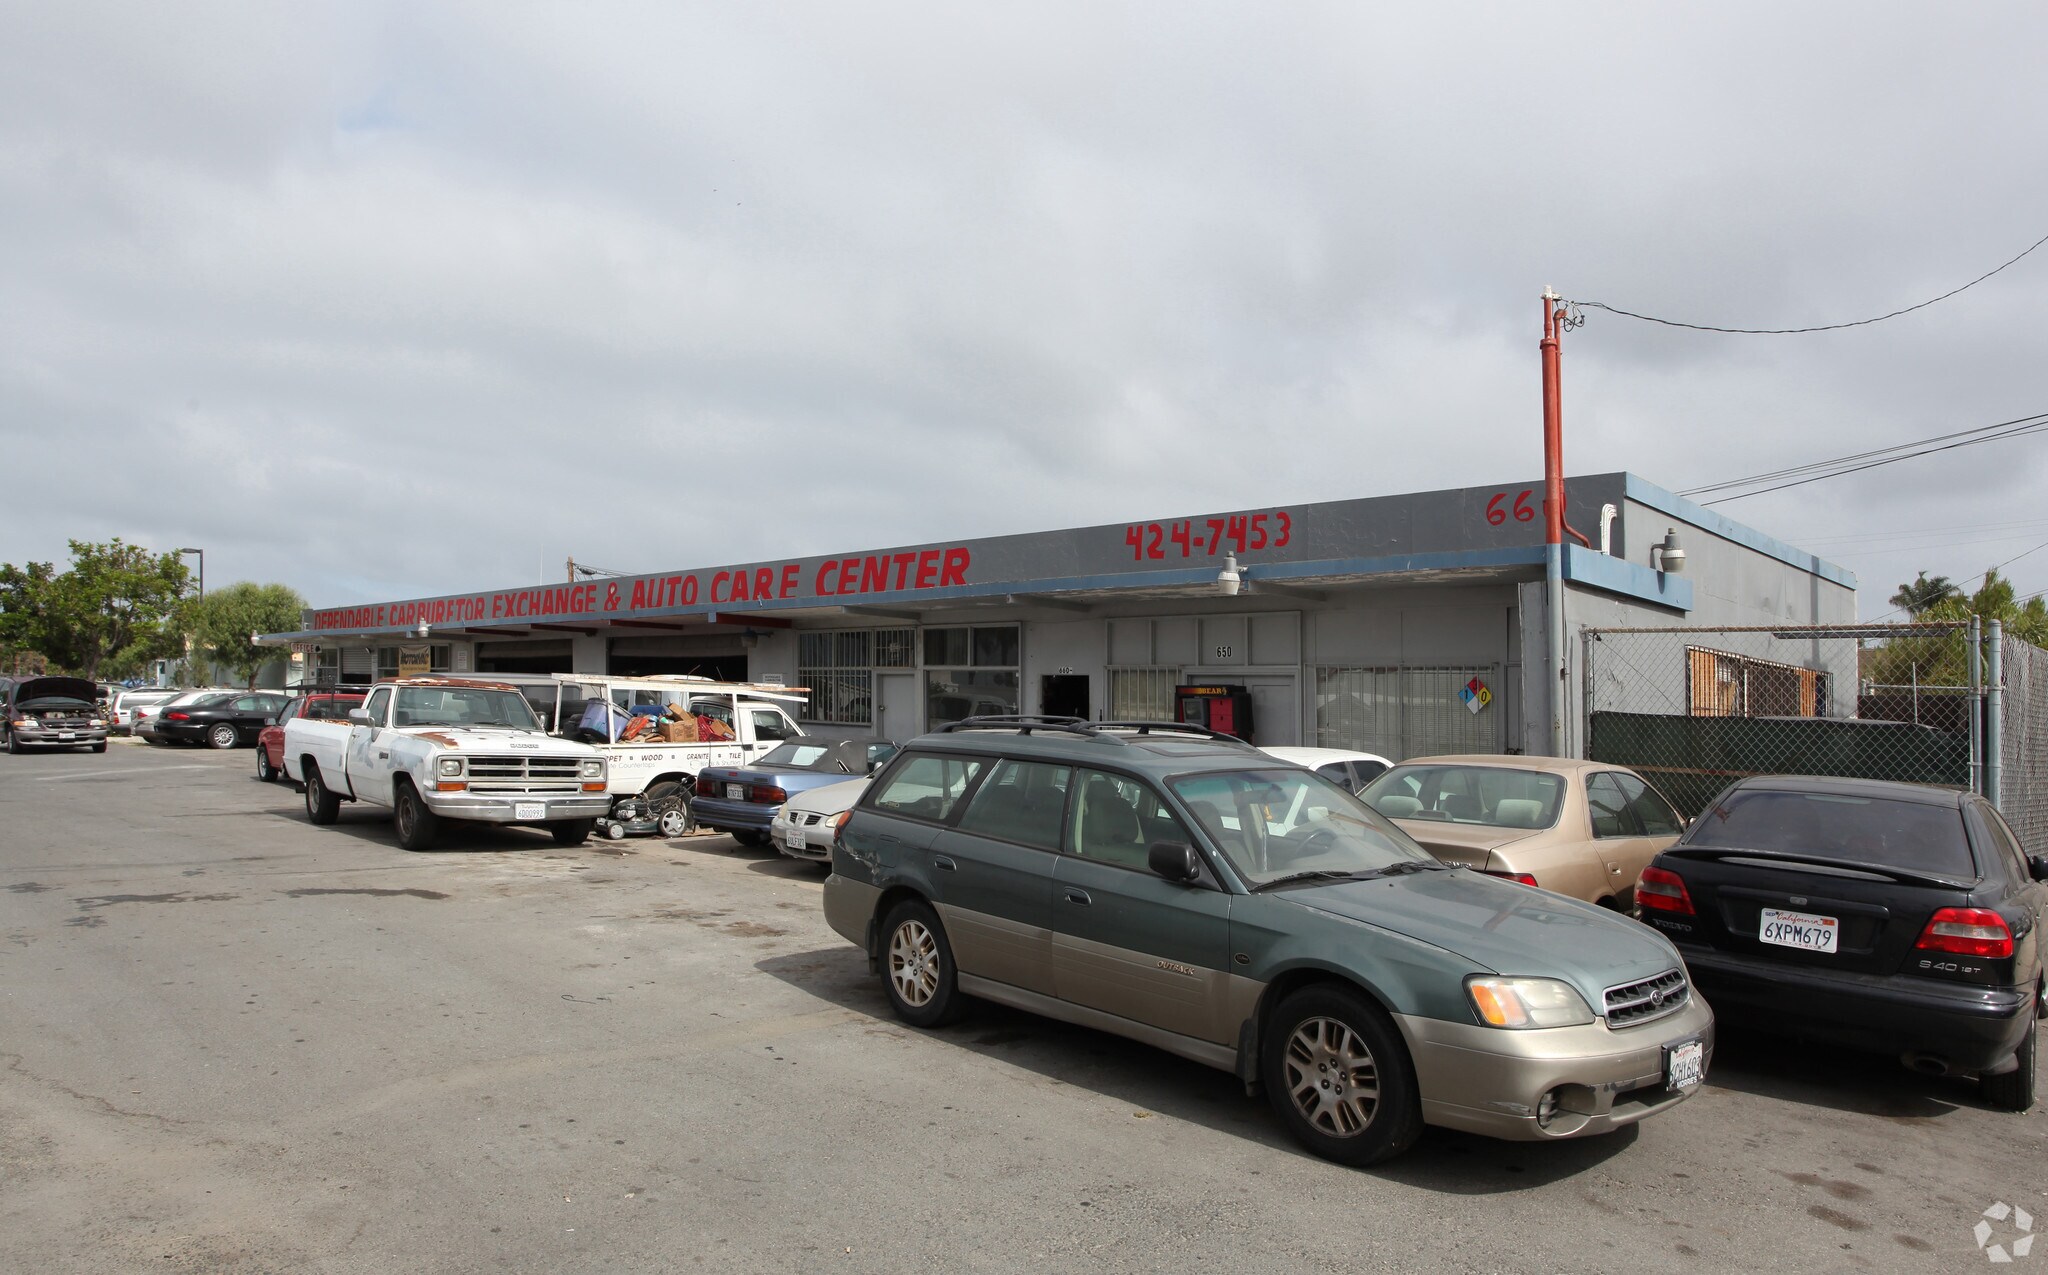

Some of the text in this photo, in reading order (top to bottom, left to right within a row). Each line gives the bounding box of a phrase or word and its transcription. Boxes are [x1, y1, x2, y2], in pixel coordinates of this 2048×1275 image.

[1125, 511, 1291, 560] 424-7453
[314, 606, 385, 630] DEPENDABLE
[492, 585, 597, 618] EXCHANGE
[604, 582, 621, 611] &
[630, 575, 698, 610] AUTO
[710, 564, 800, 603] CARE
[816, 547, 970, 596] CENTER
[292, 643, 314, 653] OFFICE
[1216, 646, 1232, 658] 650
[1202, 687, 1222, 695] BEAR
[1481, 691, 1487, 702] 0
[619, 761, 656, 769] Countertops
[1652, 918, 1692, 931] VOLVO
[1776, 911, 1819, 925] California
[1765, 922, 1832, 947] 6XPM679
[1157, 960, 1195, 975] OUTBACK
